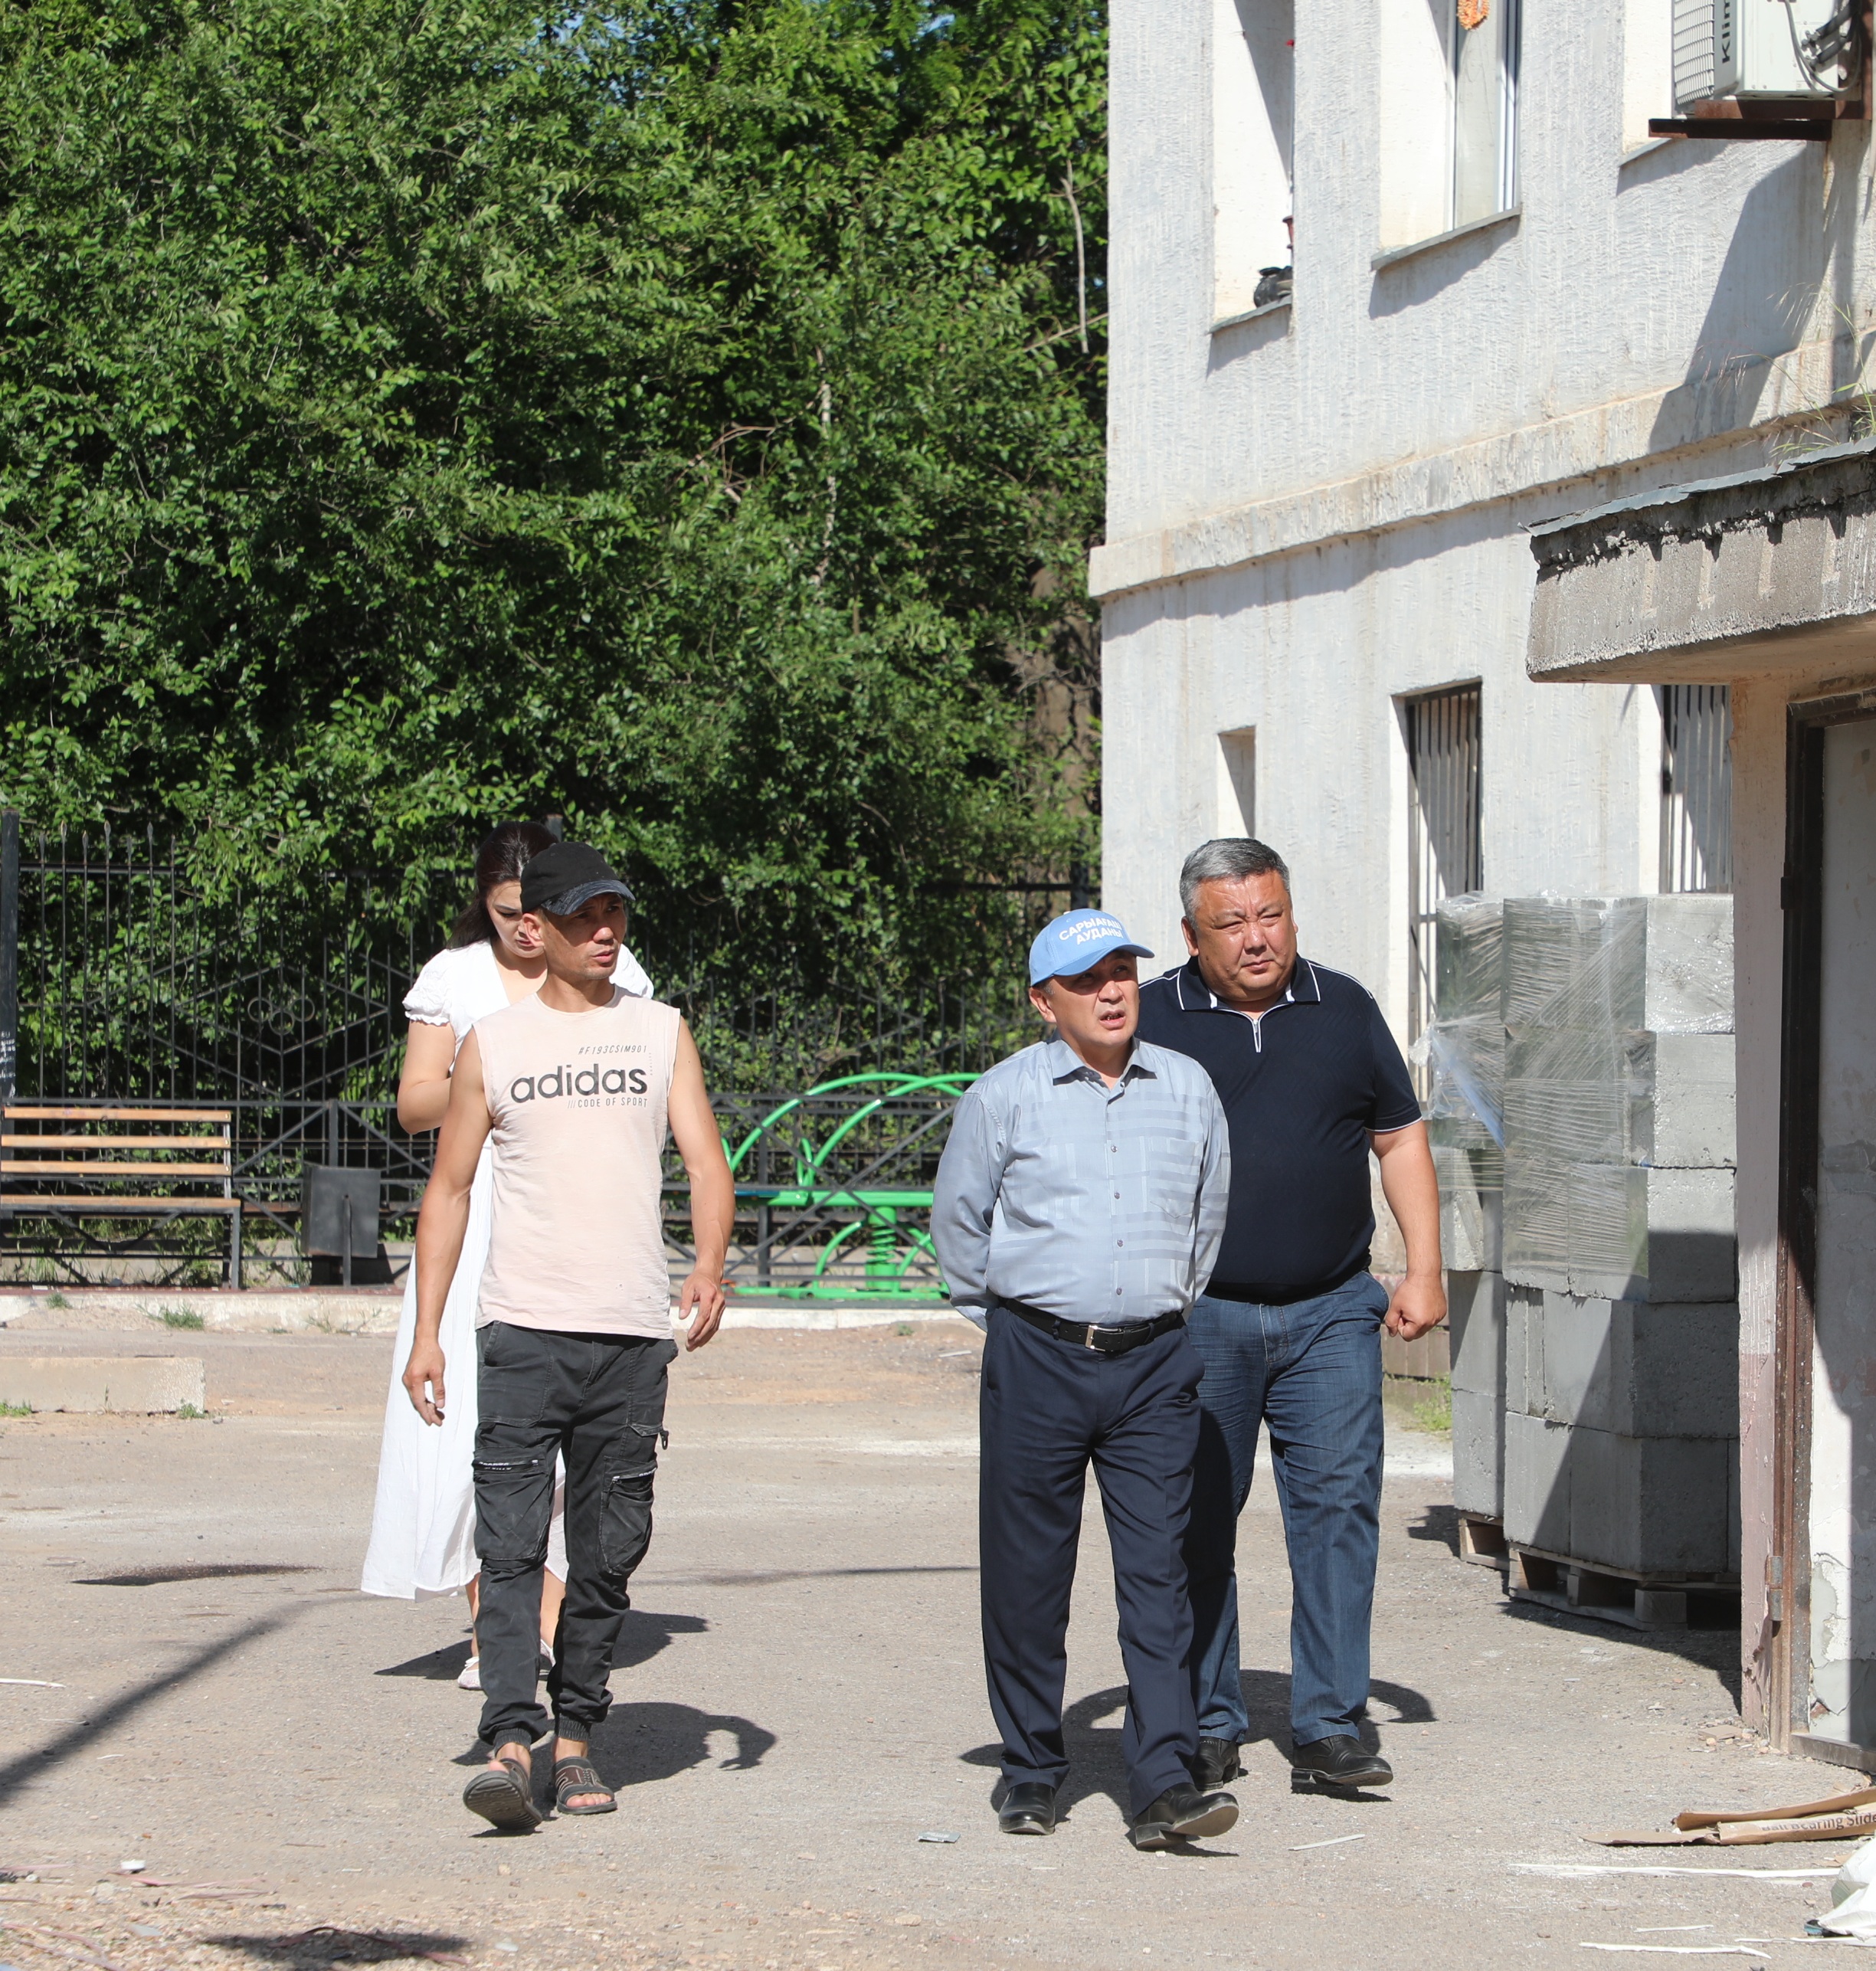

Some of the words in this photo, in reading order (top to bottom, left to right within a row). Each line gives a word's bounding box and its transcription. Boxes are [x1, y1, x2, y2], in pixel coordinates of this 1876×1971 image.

[1076, 928, 1124, 945] АУДАНЫ
[511, 1063, 647, 1103] adidas
[606, 1098, 617, 1106] OF
[621, 1097, 647, 1108] SPORT
